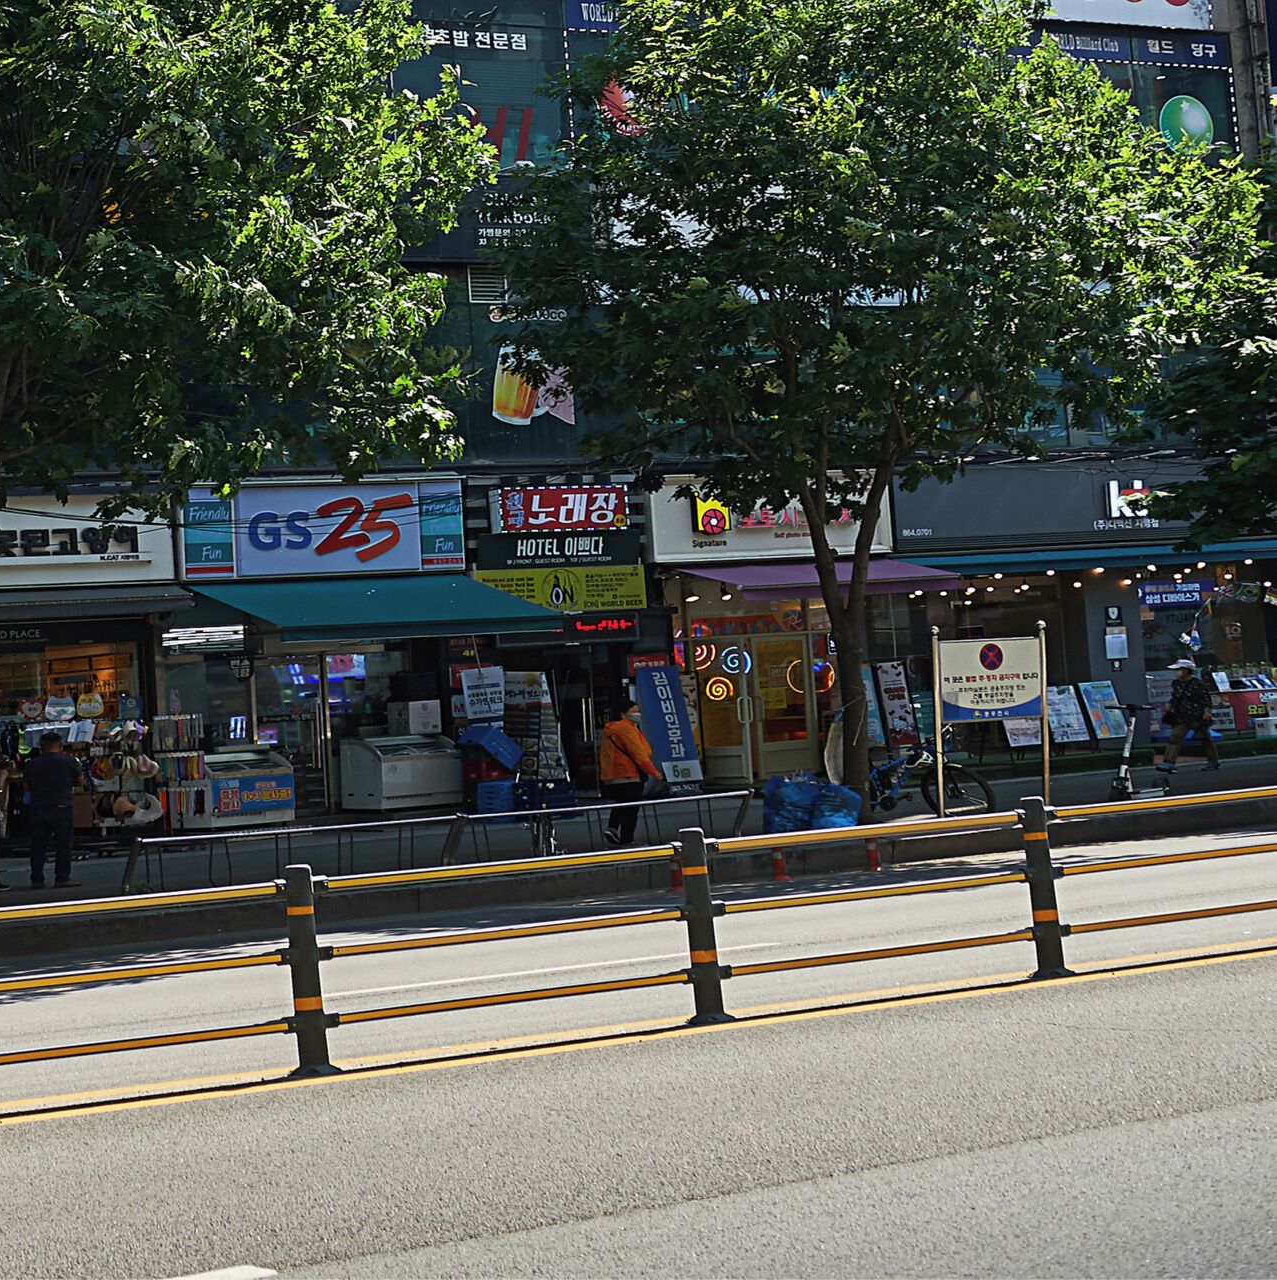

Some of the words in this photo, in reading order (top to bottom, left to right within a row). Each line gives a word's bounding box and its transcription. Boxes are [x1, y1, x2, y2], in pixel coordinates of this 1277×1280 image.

[580, 2, 614, 23] WORLD
[474, 31, 528, 52] 전문점
[1190, 42, 1218, 59] 당구
[187, 505, 231, 522] Friendly
[528, 492, 619, 525] 노래장
[247, 492, 413, 562] GS25
[201, 544, 223, 561] Fun
[434, 538, 455, 553] Fun
[516, 537, 561, 557] HOTEL
[564, 535, 605, 556] 이쁘다
[600, 600, 625, 609] WORLD
[9, 628, 42, 640] PLACE
[651, 671, 686, 758] 김이비인후과
